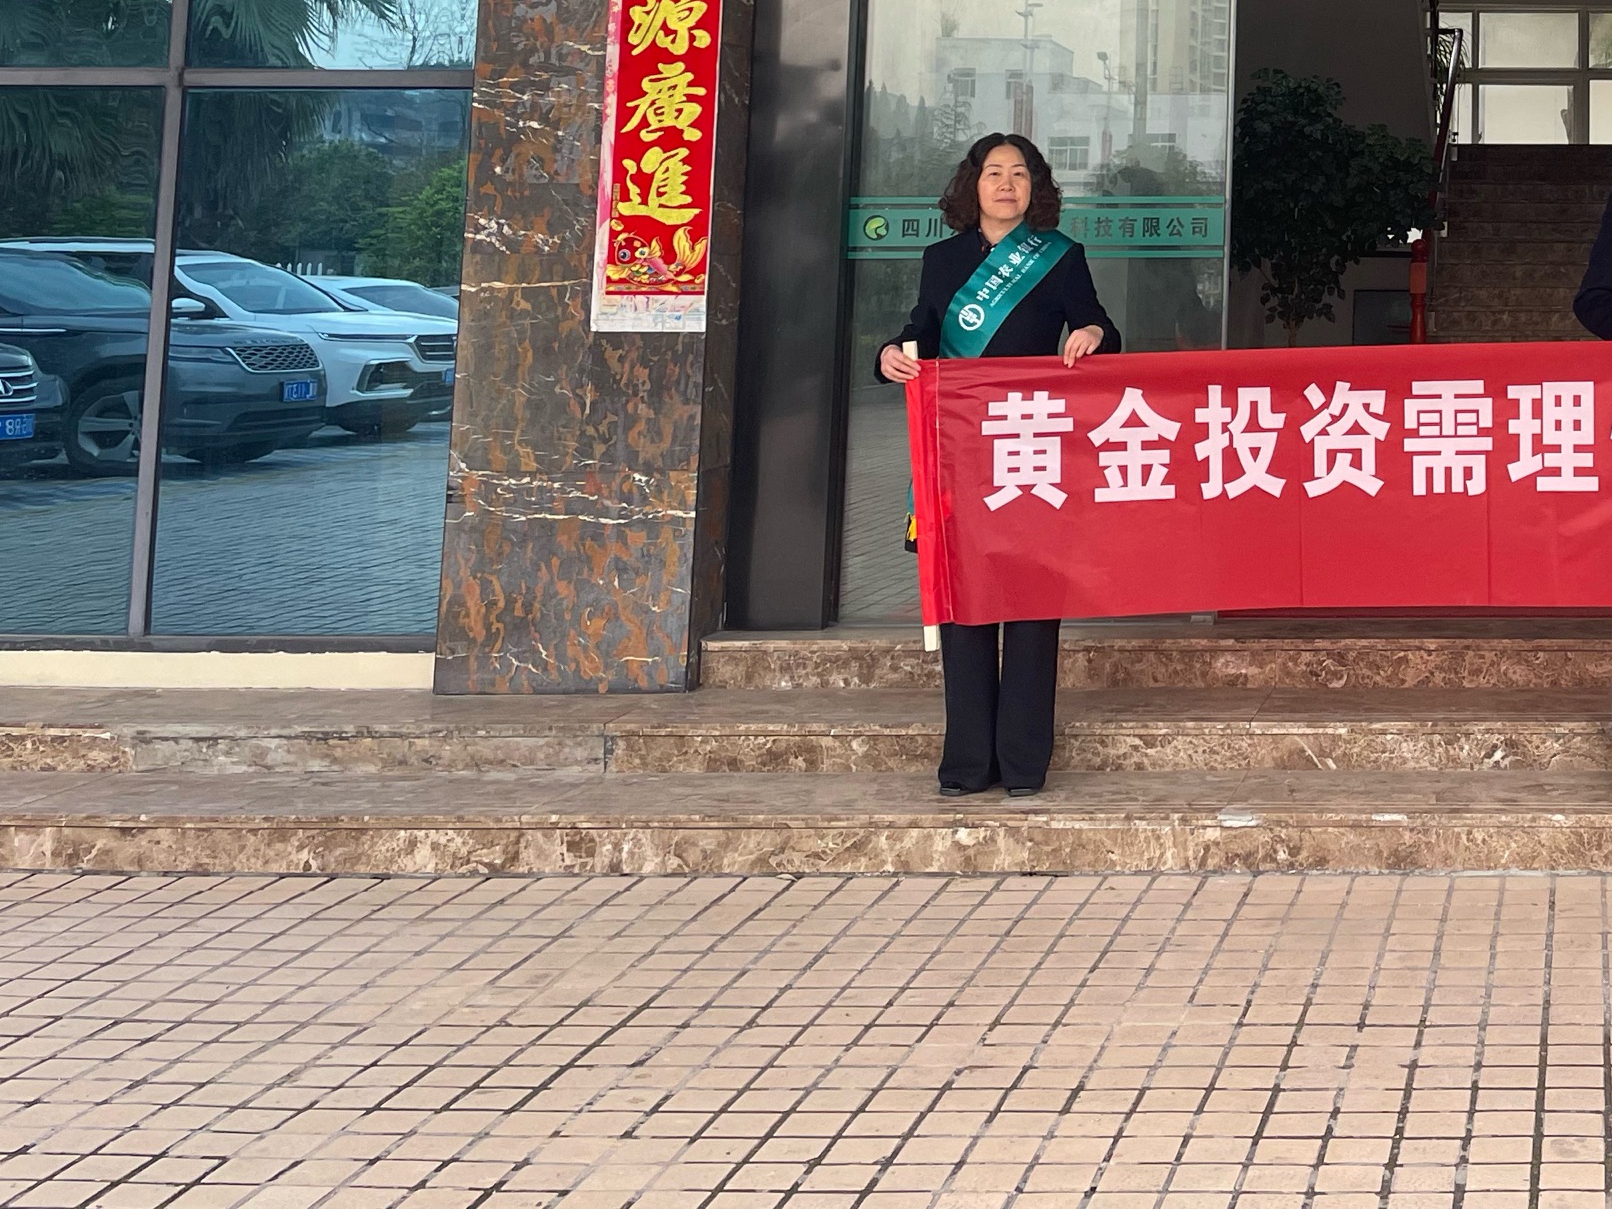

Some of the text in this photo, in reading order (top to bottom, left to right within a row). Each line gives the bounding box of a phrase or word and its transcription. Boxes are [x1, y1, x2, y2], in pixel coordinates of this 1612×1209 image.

[976, 235, 1042, 301] 中国农业银行
